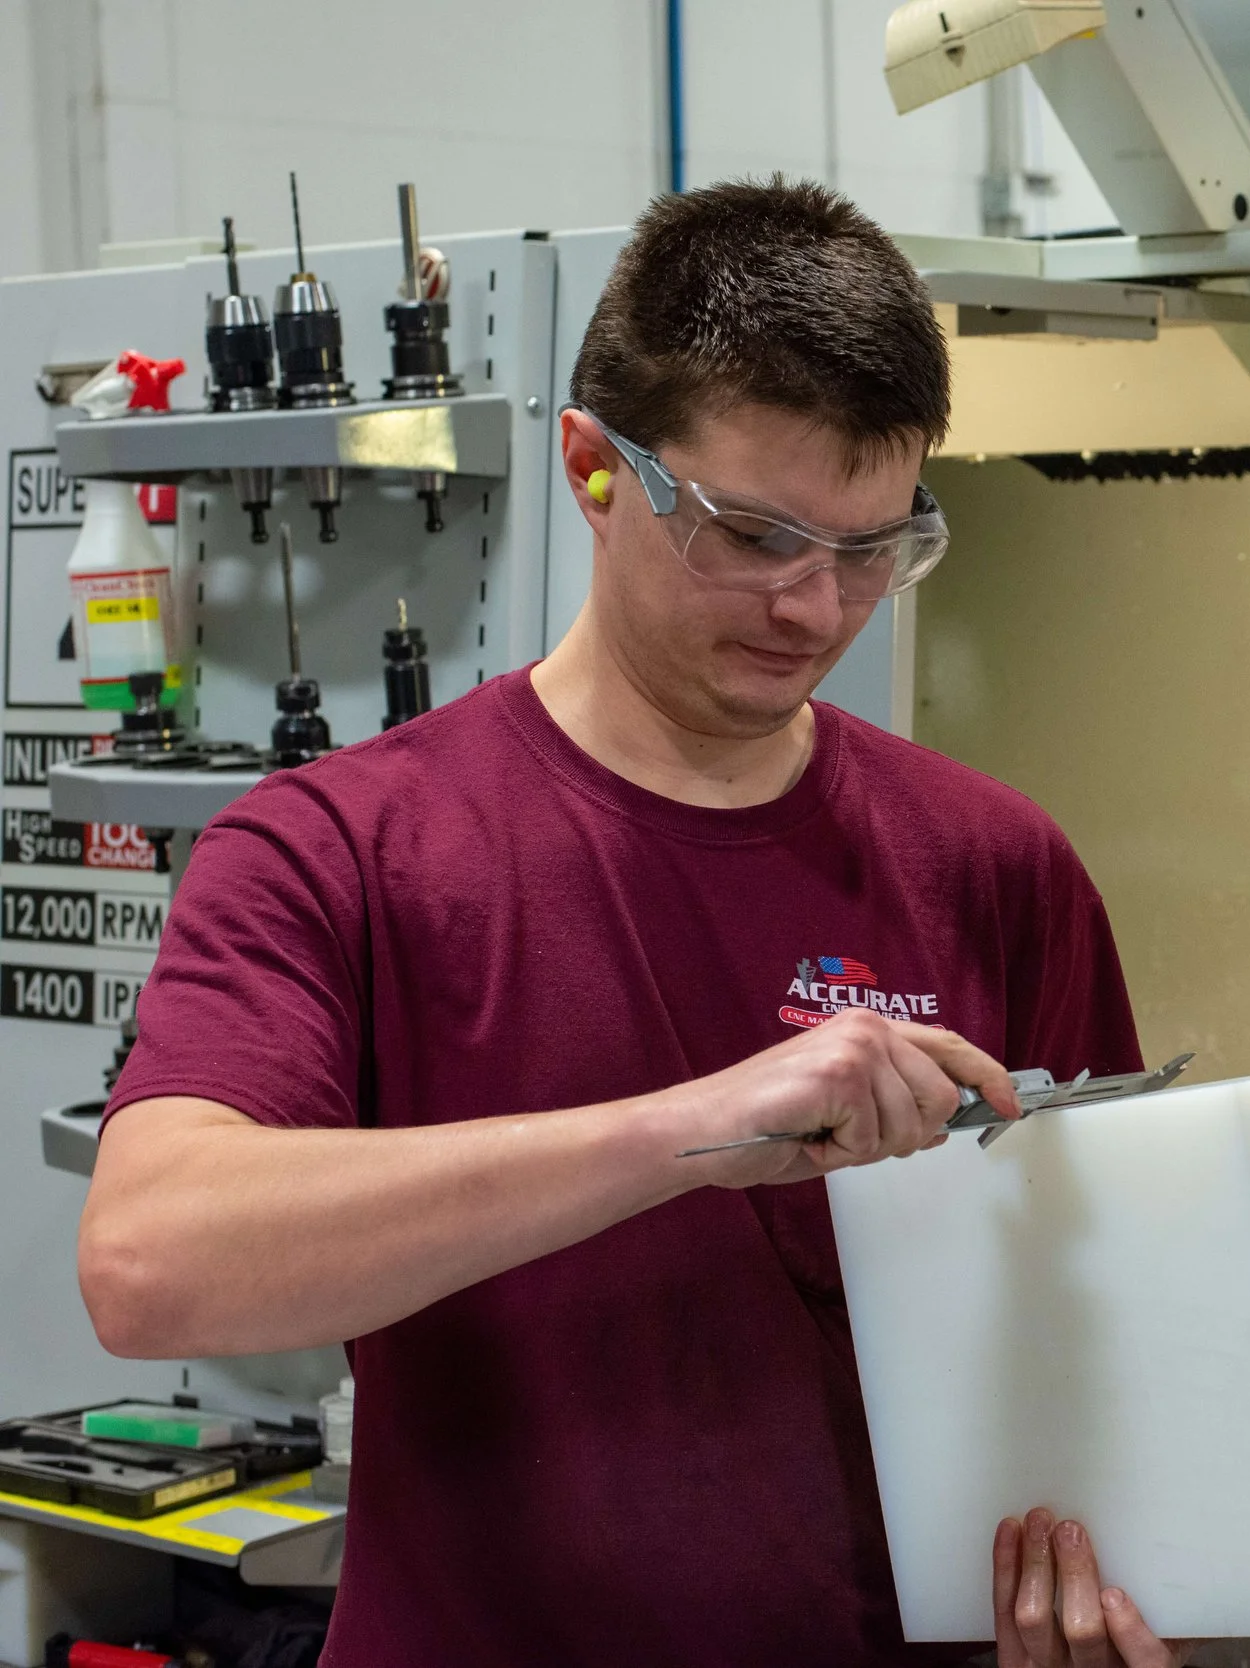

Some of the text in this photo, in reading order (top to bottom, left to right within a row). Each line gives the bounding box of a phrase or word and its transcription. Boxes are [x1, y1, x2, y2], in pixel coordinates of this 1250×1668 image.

[17, 466, 86, 514] SUPE
[19, 833, 82, 863] SPEED
[91, 822, 149, 848] TOO
[86, 847, 157, 867] CHANG
[5, 894, 163, 941] 12,000 RPM
[13, 970, 83, 1018] 1400
[786, 977, 939, 1015] ACCURATE
[787, 1011, 806, 1023] CNC
